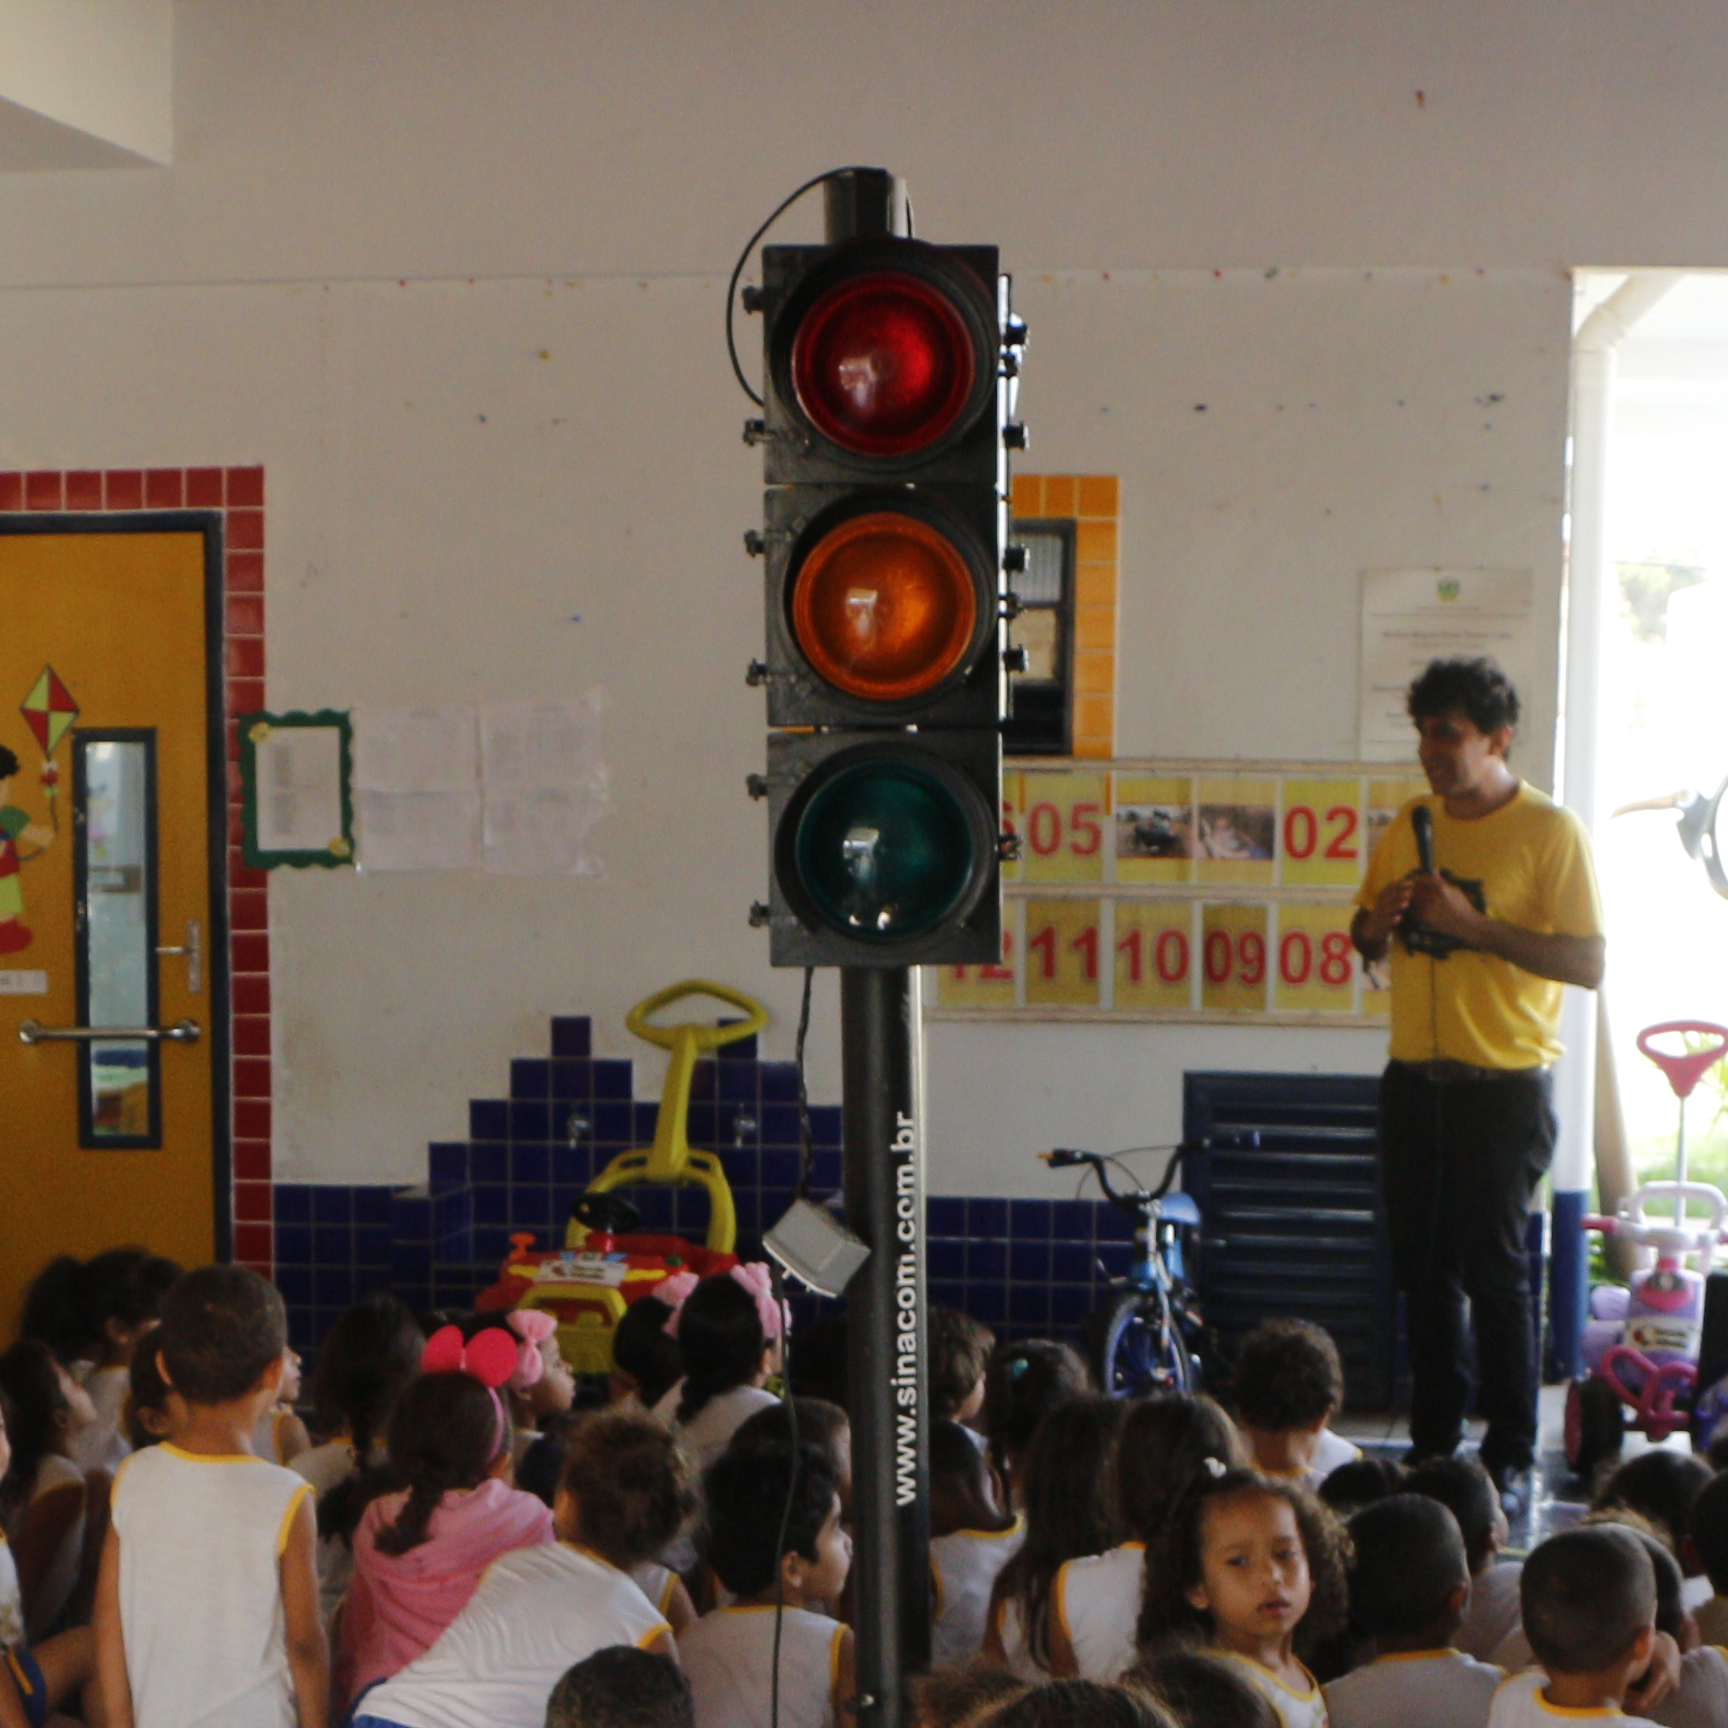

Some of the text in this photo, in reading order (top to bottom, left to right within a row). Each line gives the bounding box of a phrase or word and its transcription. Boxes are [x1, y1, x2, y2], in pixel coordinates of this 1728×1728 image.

[1027, 802, 1103, 857] 05
[1283, 805, 1359, 860] 02
[1028, 925, 1098, 980] 11
[1118, 928, 1190, 983] 10
[1204, 929, 1267, 986] 09
[1279, 930, 1354, 986] 08
[890, 1111, 917, 1507] www.sinacom.com.br
